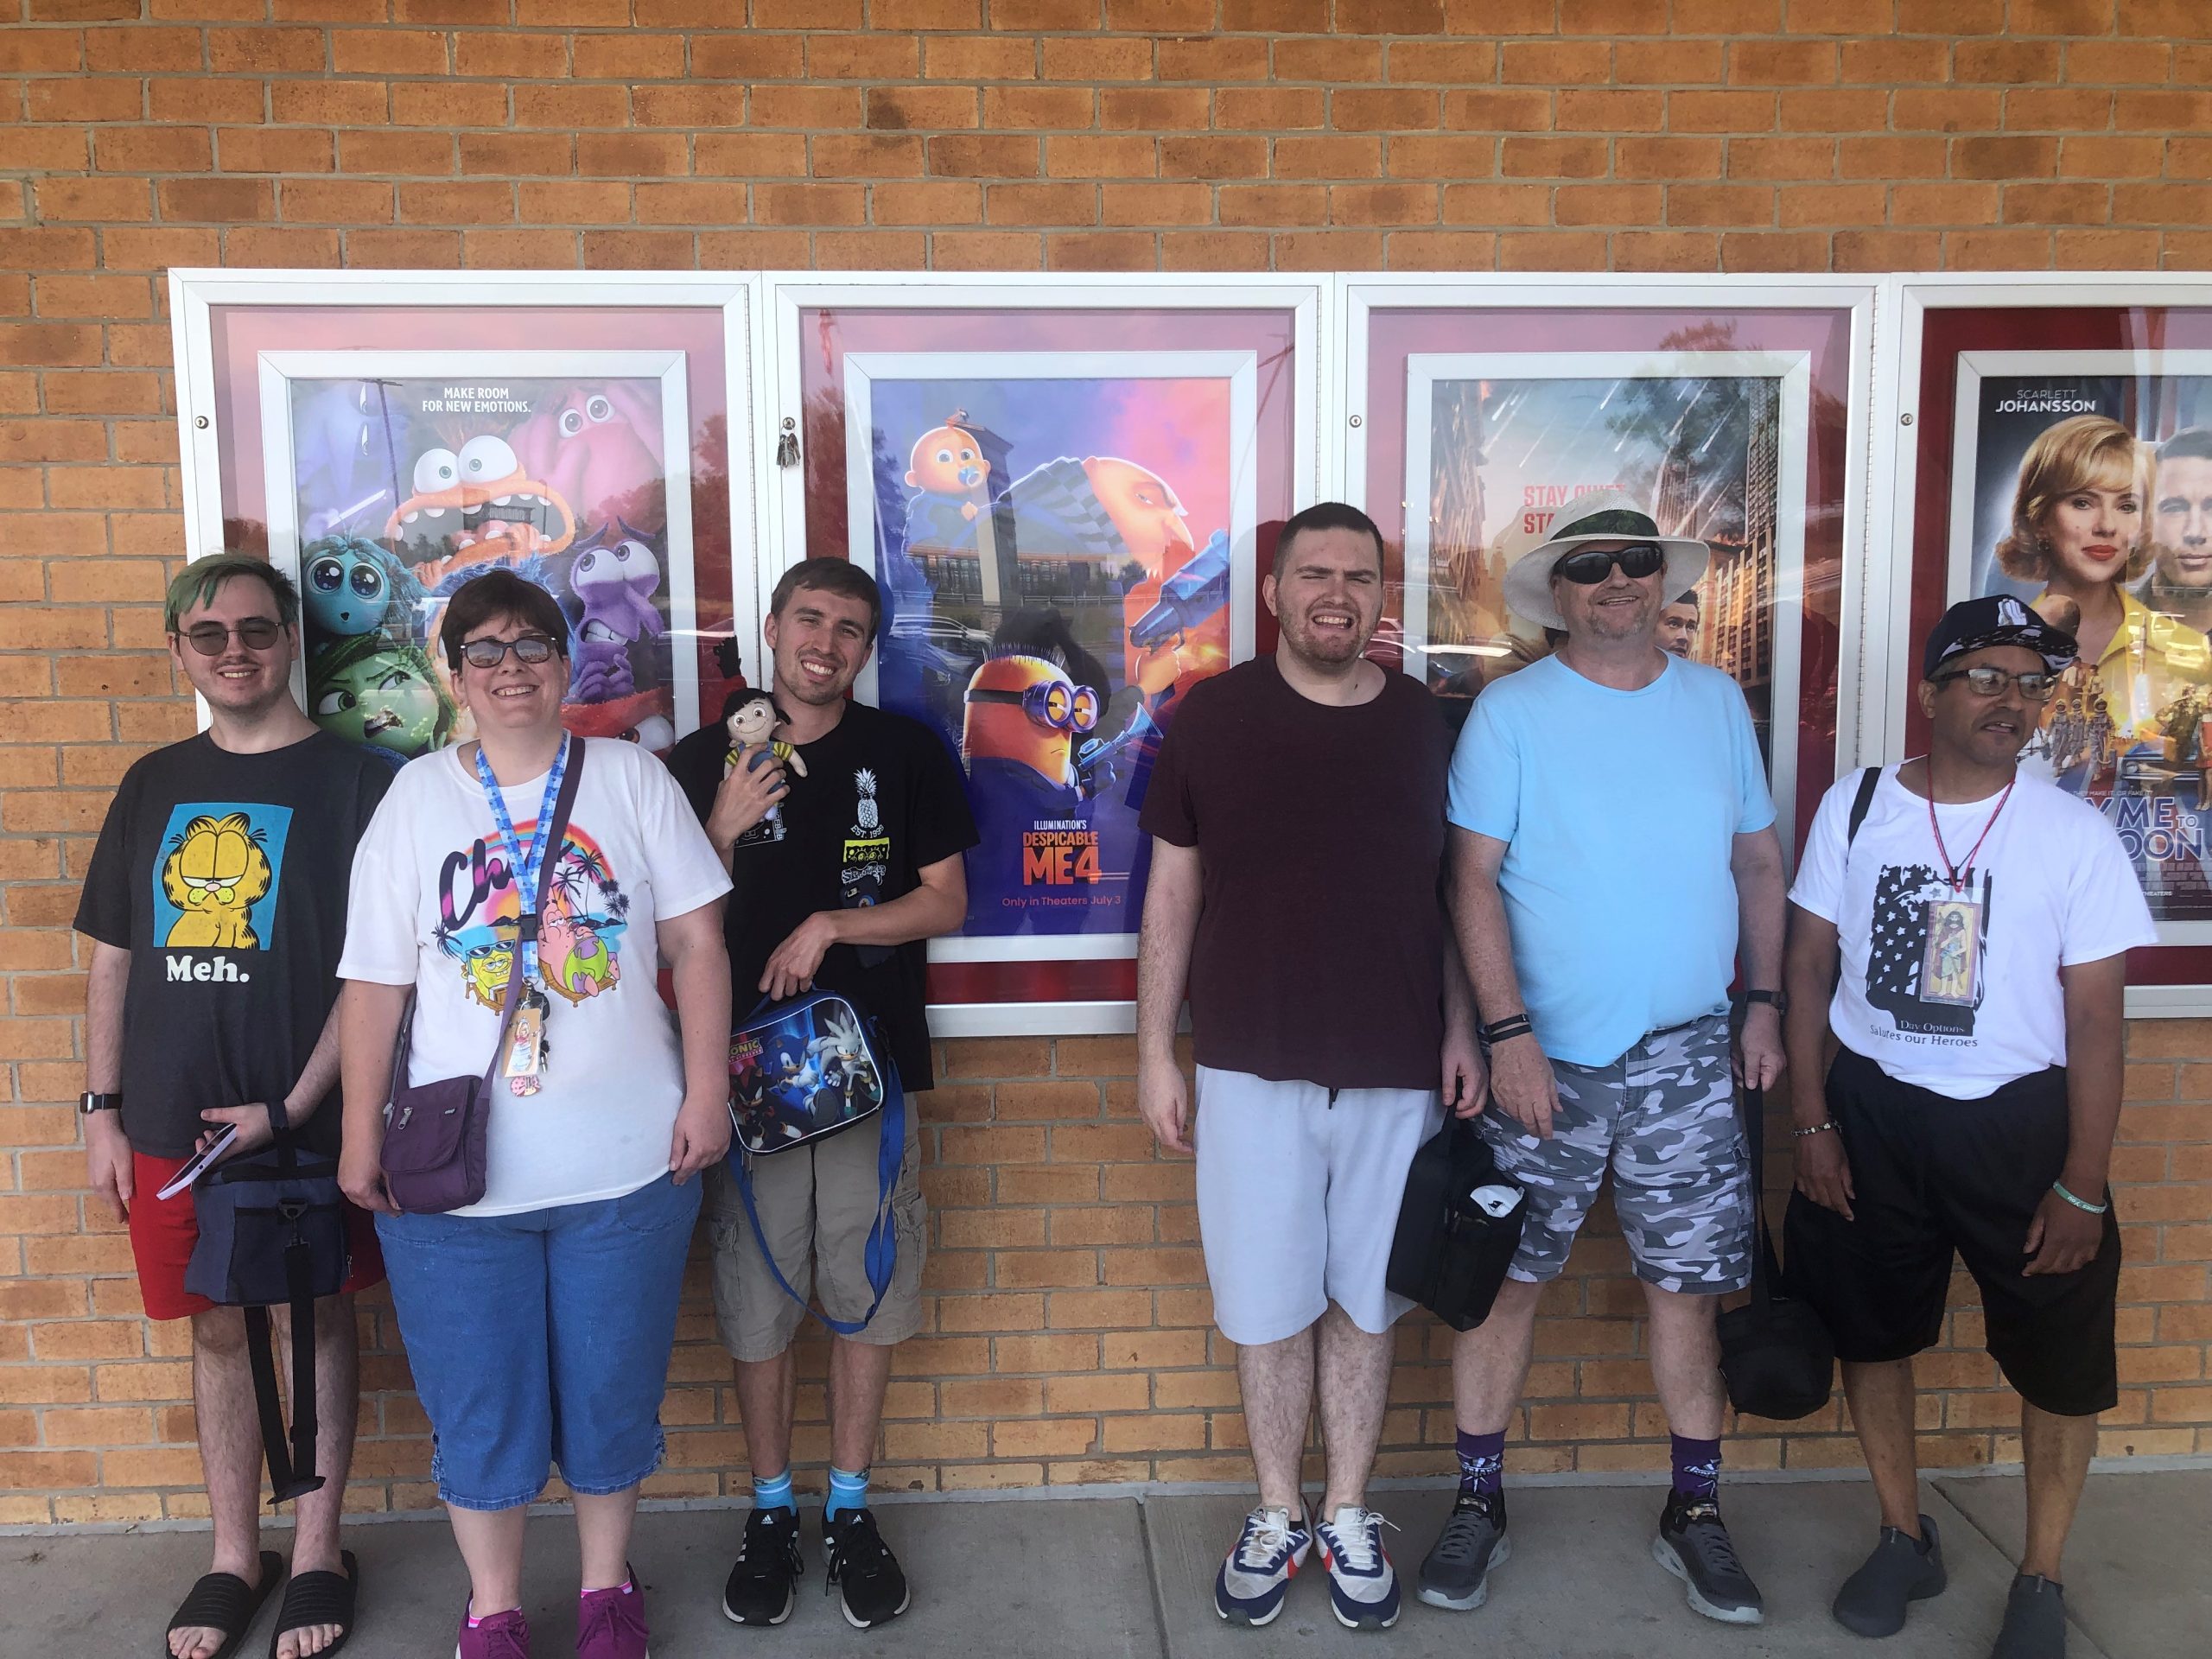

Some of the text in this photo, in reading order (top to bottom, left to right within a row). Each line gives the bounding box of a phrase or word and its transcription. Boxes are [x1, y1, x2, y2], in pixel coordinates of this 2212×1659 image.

[443, 387, 510, 399] MAKE ROOM
[2017, 389, 2077, 399] SCARLETT
[422, 400, 531, 413] FOR NEW EMOTIONS.
[1995, 400, 2096, 413] JOHANSSON
[1523, 485, 1568, 506] STAY
[2115, 797, 2175, 830] ME
[2176, 815, 2198, 829] TO
[1033, 819, 1087, 830] ILLUMINATION'S
[1023, 831, 1099, 847] DESPICABLE
[2116, 828, 2204, 861] OON
[1001, 895, 1121, 908] Only in Theaters July 3
[165, 955, 250, 982] Meh.
[1901, 1020, 1965, 1033] Day Options
[1870, 1024, 1978, 1047] Salutes our Heroes
[729, 1039, 759, 1055] ONIC
